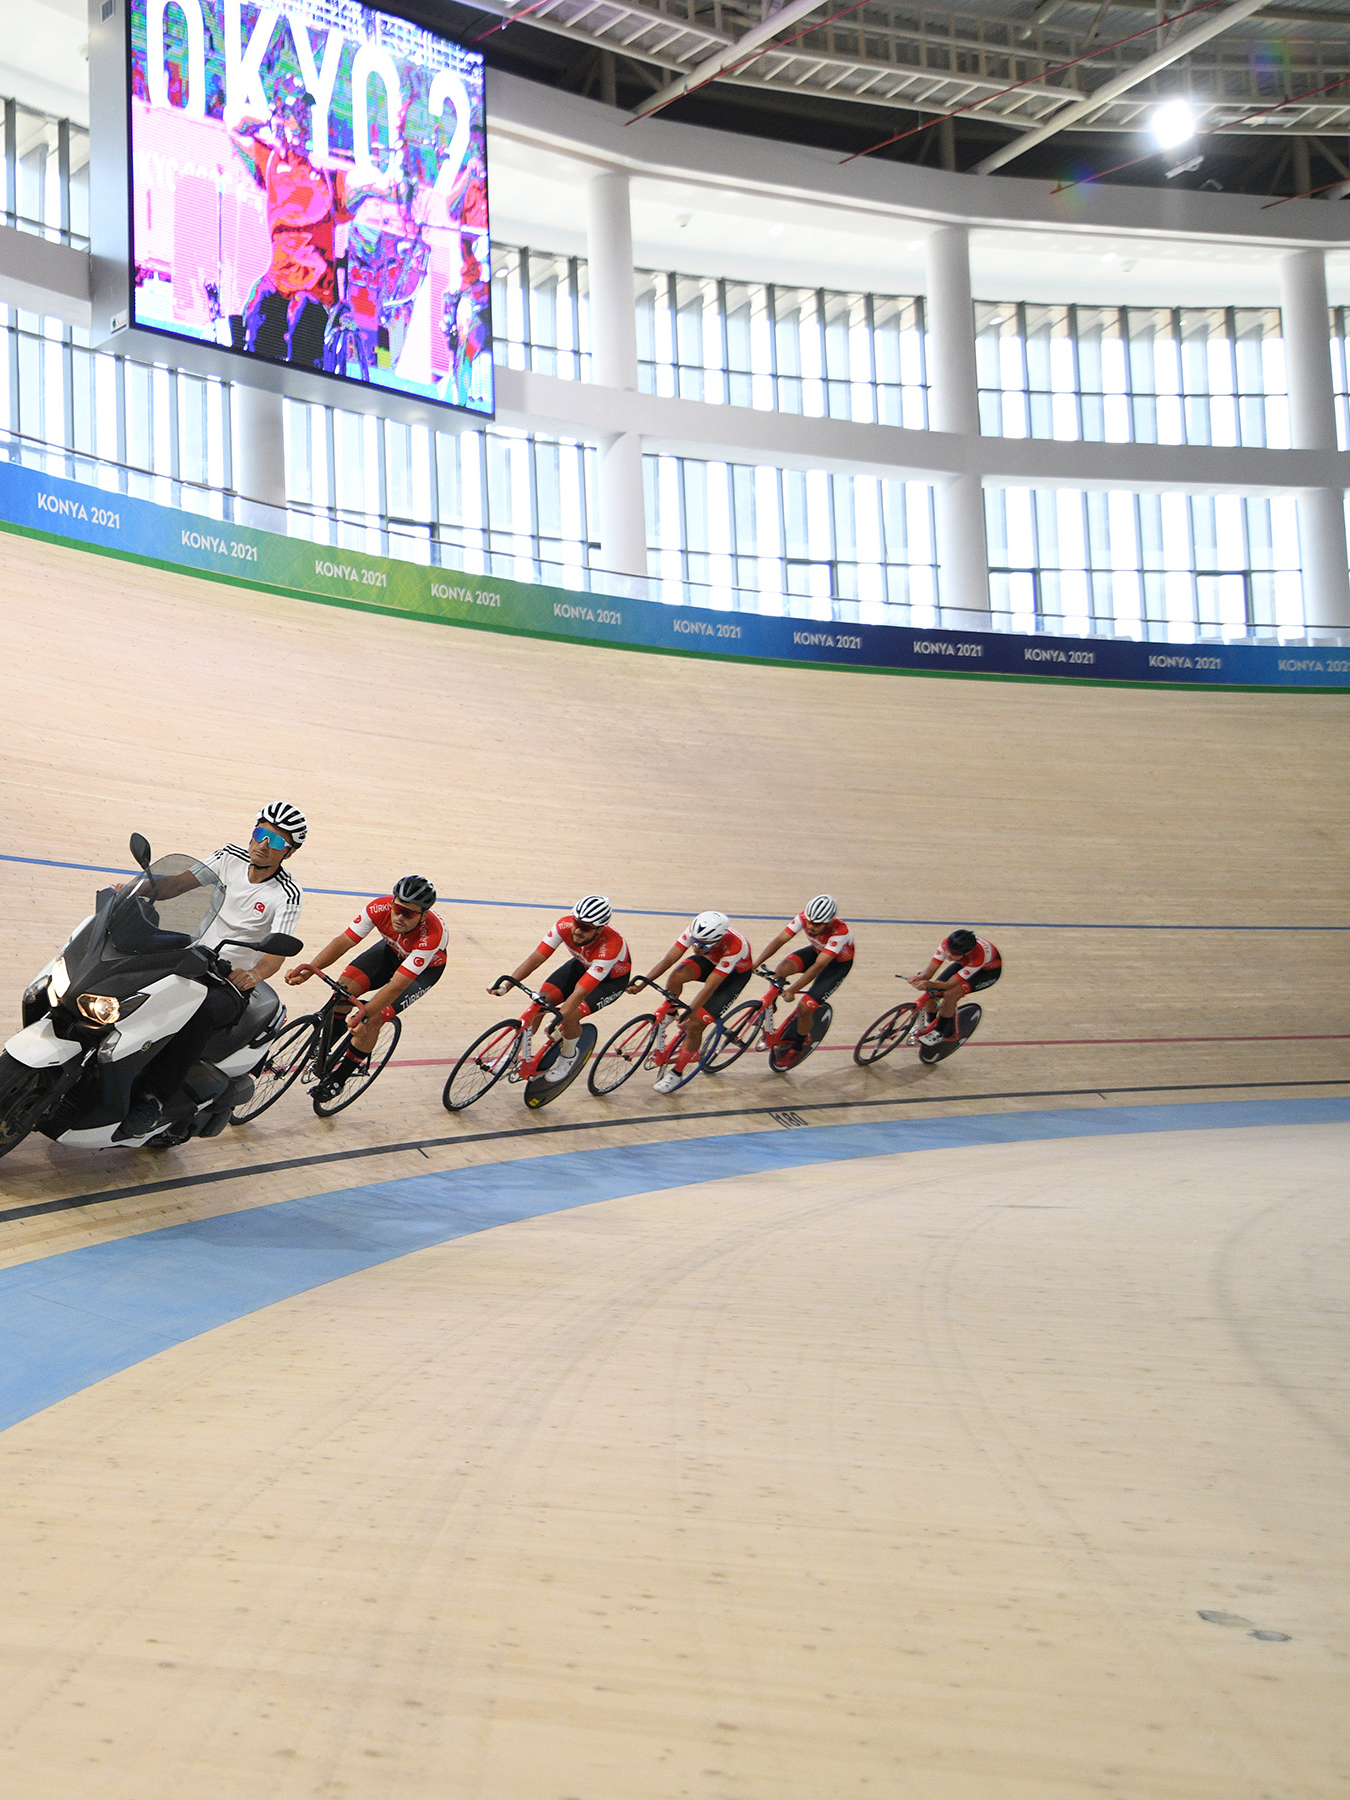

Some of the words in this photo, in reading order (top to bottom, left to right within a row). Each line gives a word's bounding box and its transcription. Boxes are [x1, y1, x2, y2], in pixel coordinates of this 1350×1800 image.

[37, 492, 89, 522] KONYA
[90, 506, 121, 530] 2021
[181, 530, 229, 556] KONYA
[230, 541, 258, 562] 2021
[314, 560, 359, 583] KONYA
[360, 568, 387, 588] 2021
[430, 583, 474, 604] KONYA
[475, 590, 501, 608] 2021
[553, 603, 595, 622] KONYA
[596, 608, 622, 625] 2021
[673, 619, 715, 637] KONYA
[716, 624, 742, 639] 2021
[793, 631, 835, 648] KONYA
[835, 635, 862, 649] 2021
[913, 641, 956, 656] KONYA
[956, 643, 982, 657] 2021
[1024, 649, 1067, 663] KONYA
[1067, 651, 1095, 664] 2021
[1148, 656, 1194, 669] KONYA
[1194, 657, 1222, 670] 2021
[1278, 660, 1325, 673] KONYA
[1325, 660, 1350, 673] 202
[775, 1112, 809, 1128] 180
